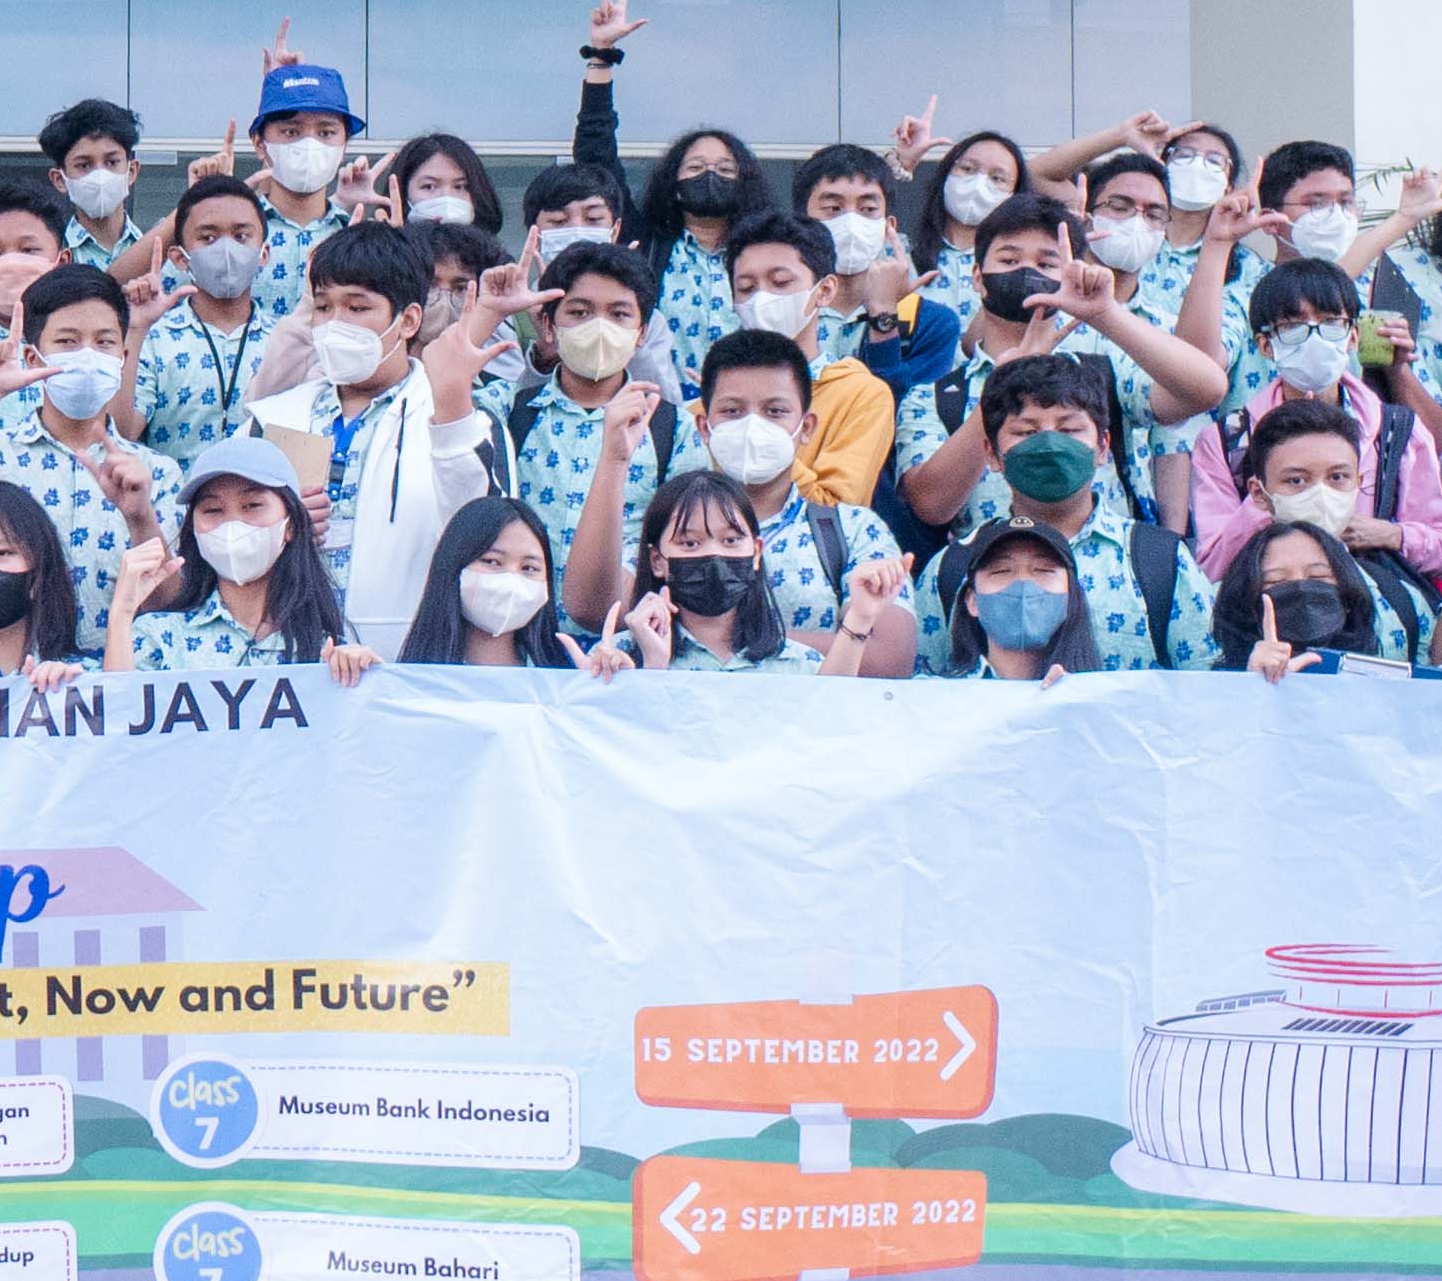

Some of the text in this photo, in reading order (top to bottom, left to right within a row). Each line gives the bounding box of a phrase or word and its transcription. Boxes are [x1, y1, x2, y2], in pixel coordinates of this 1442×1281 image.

[129, 677, 308, 736] JAYA
[46, 974, 163, 1018] Now
[180, 971, 275, 1015] and
[643, 1038, 938, 1063] 15 SEPTEMBER 2022
[279, 1097, 550, 1123] Museum Bank Indonesia
[195, 1117, 218, 1149] 7
[691, 1199, 975, 1231] 22 SEPTEMBER 2022
[327, 1252, 499, 1280] Museum Bahari
